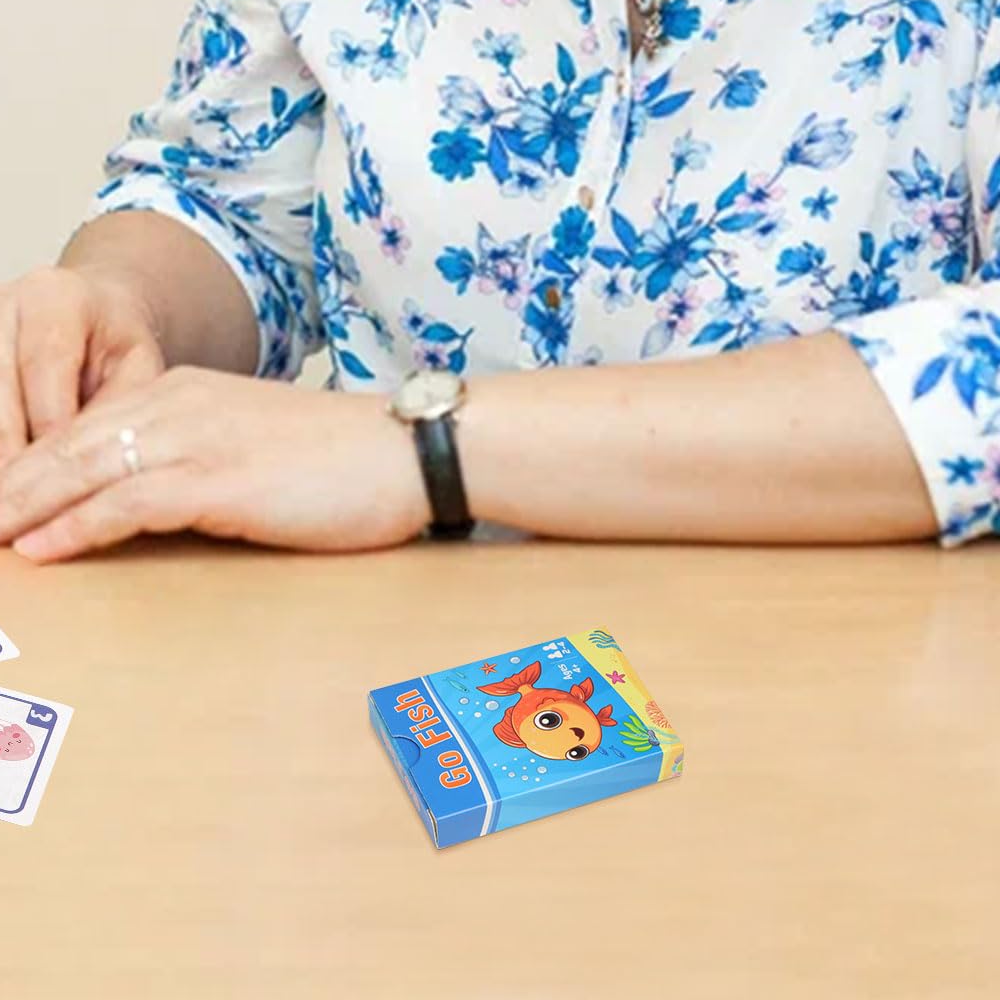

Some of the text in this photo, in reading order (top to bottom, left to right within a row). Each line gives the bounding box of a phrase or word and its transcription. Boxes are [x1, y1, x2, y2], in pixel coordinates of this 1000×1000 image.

[30, 709, 53, 722] 3
[394, 688, 452, 749] Fish
[437, 749, 472, 789] Go
